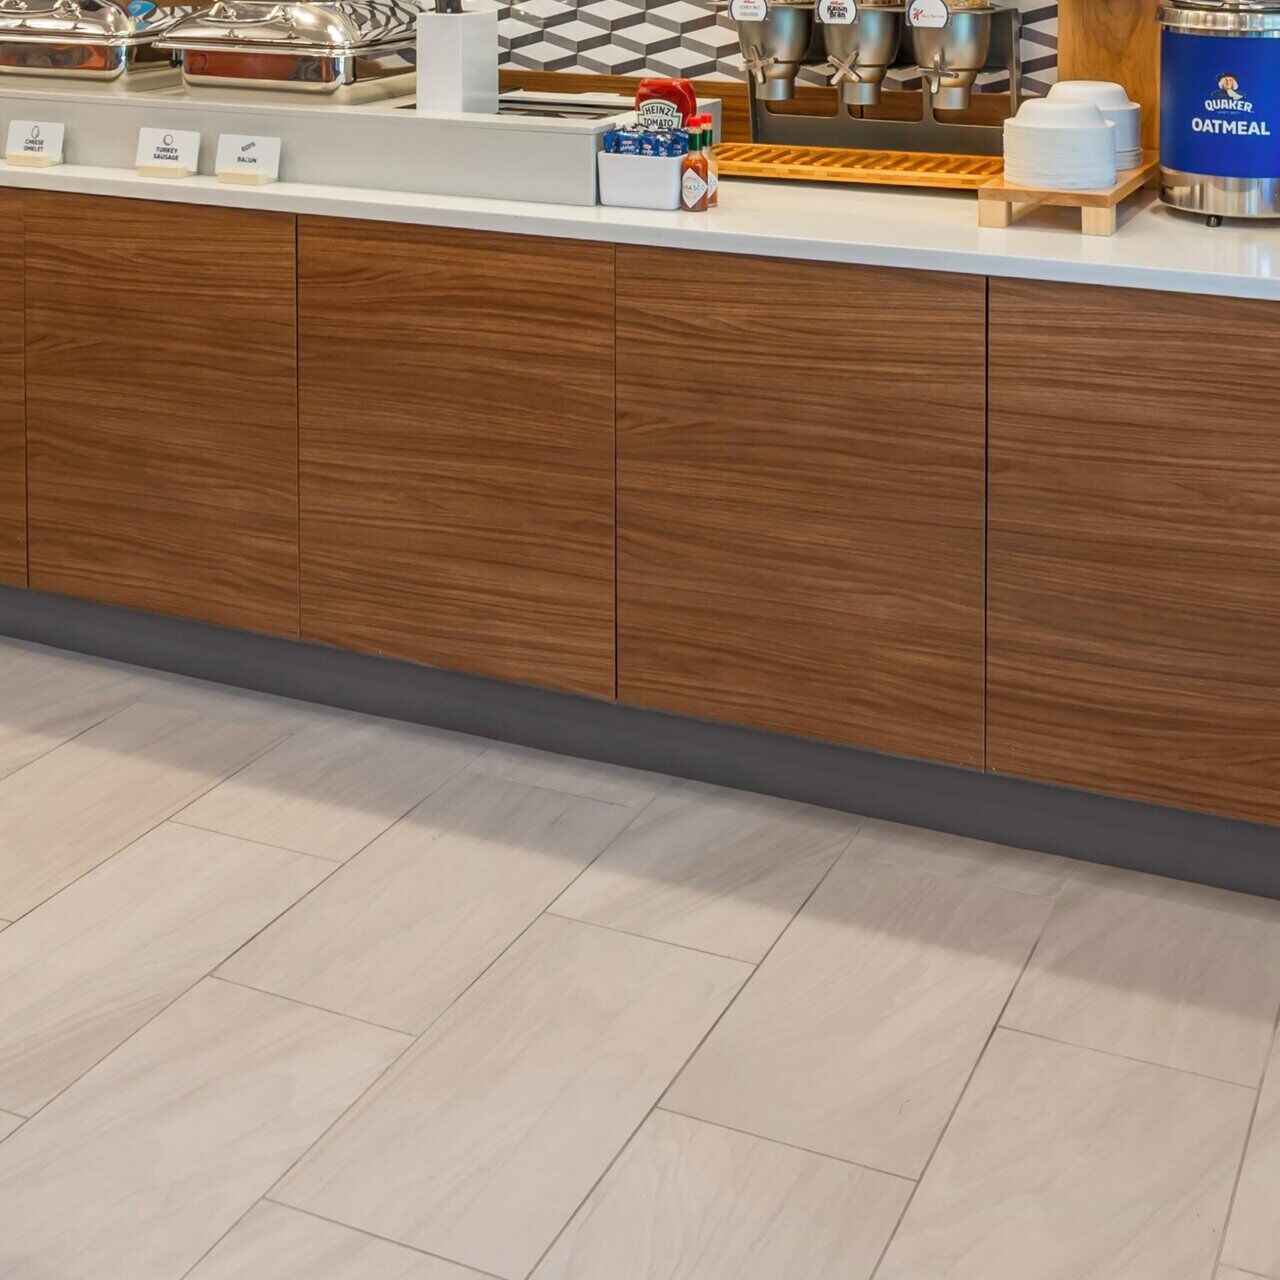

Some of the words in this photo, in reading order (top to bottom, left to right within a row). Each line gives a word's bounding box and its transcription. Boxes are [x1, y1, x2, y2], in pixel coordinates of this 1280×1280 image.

[644, 105, 672, 117] HEINZ
[1204, 99, 1253, 113] QUAKER
[643, 118, 674, 127] TOMATO
[1191, 117, 1271, 135] OATMEAL
